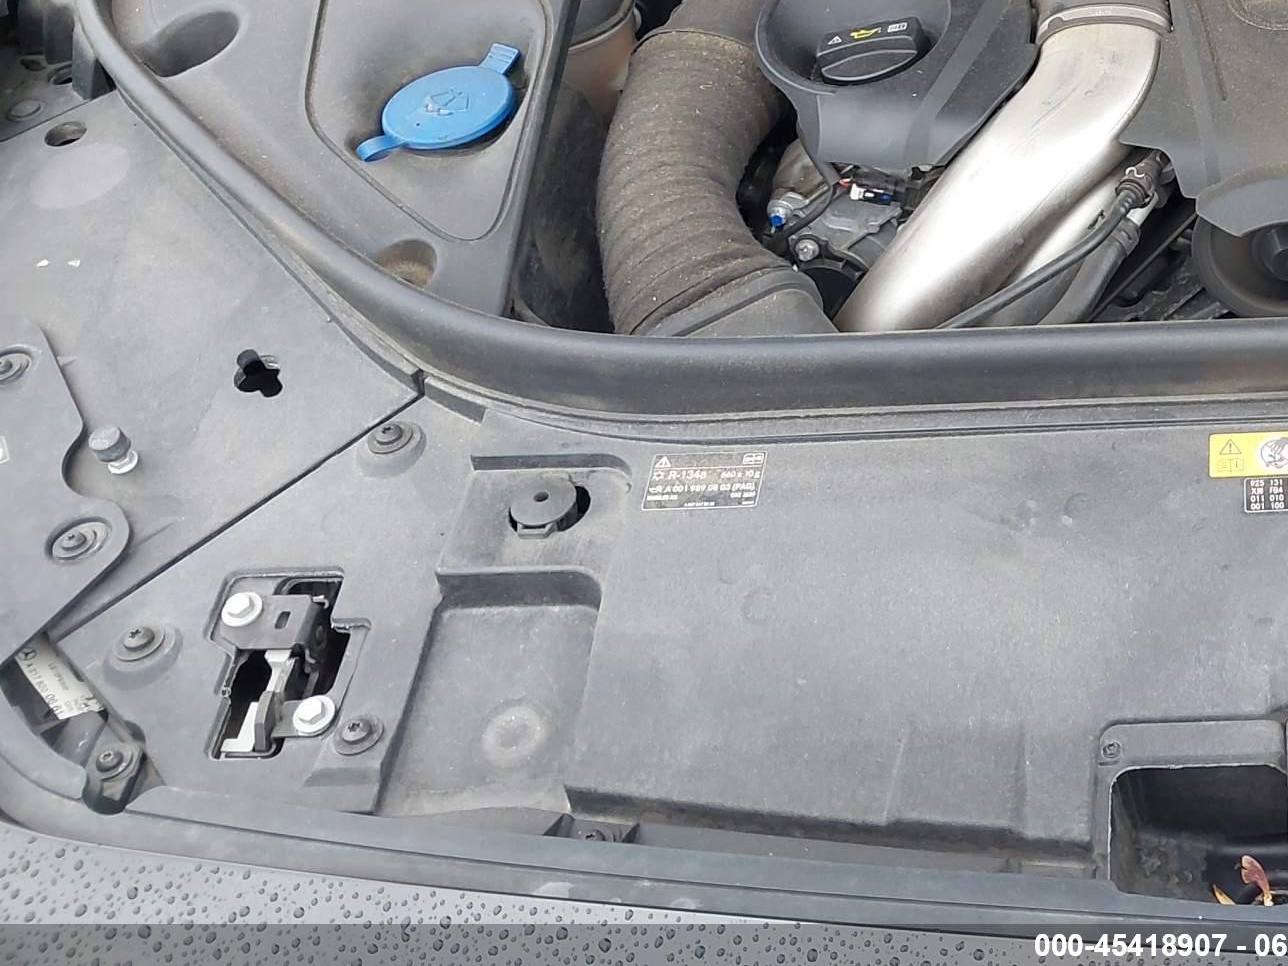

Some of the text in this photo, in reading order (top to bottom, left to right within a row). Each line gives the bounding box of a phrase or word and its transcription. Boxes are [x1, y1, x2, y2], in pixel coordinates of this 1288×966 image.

[1250, 479, 1265, 487] 925
[1270, 478, 1283, 486] 131
[1250, 495, 1265, 503] 011
[1269, 494, 1285, 502] 010
[1250, 502, 1265, 510] 001
[1270, 501, 1285, 510] 100
